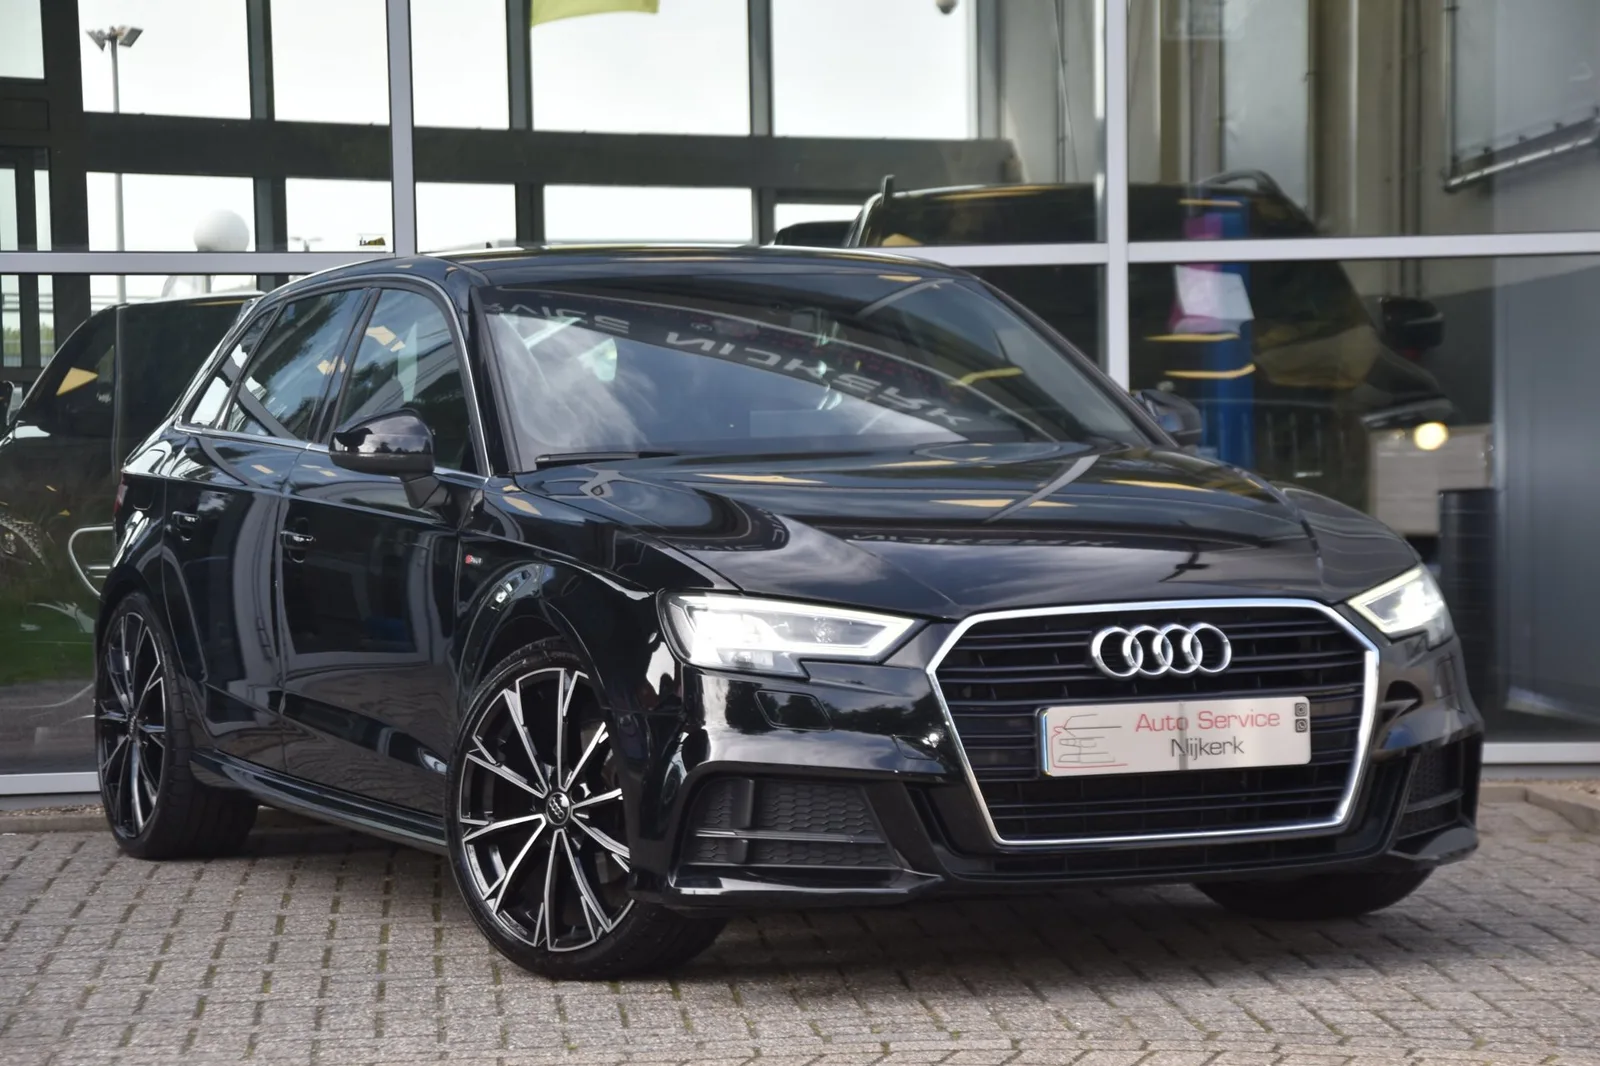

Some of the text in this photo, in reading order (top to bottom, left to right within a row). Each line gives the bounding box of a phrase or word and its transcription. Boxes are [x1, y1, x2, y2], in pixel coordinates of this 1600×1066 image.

[1135, 709, 1281, 733] Auto Service
[1170, 735, 1245, 761] Nijkerk
